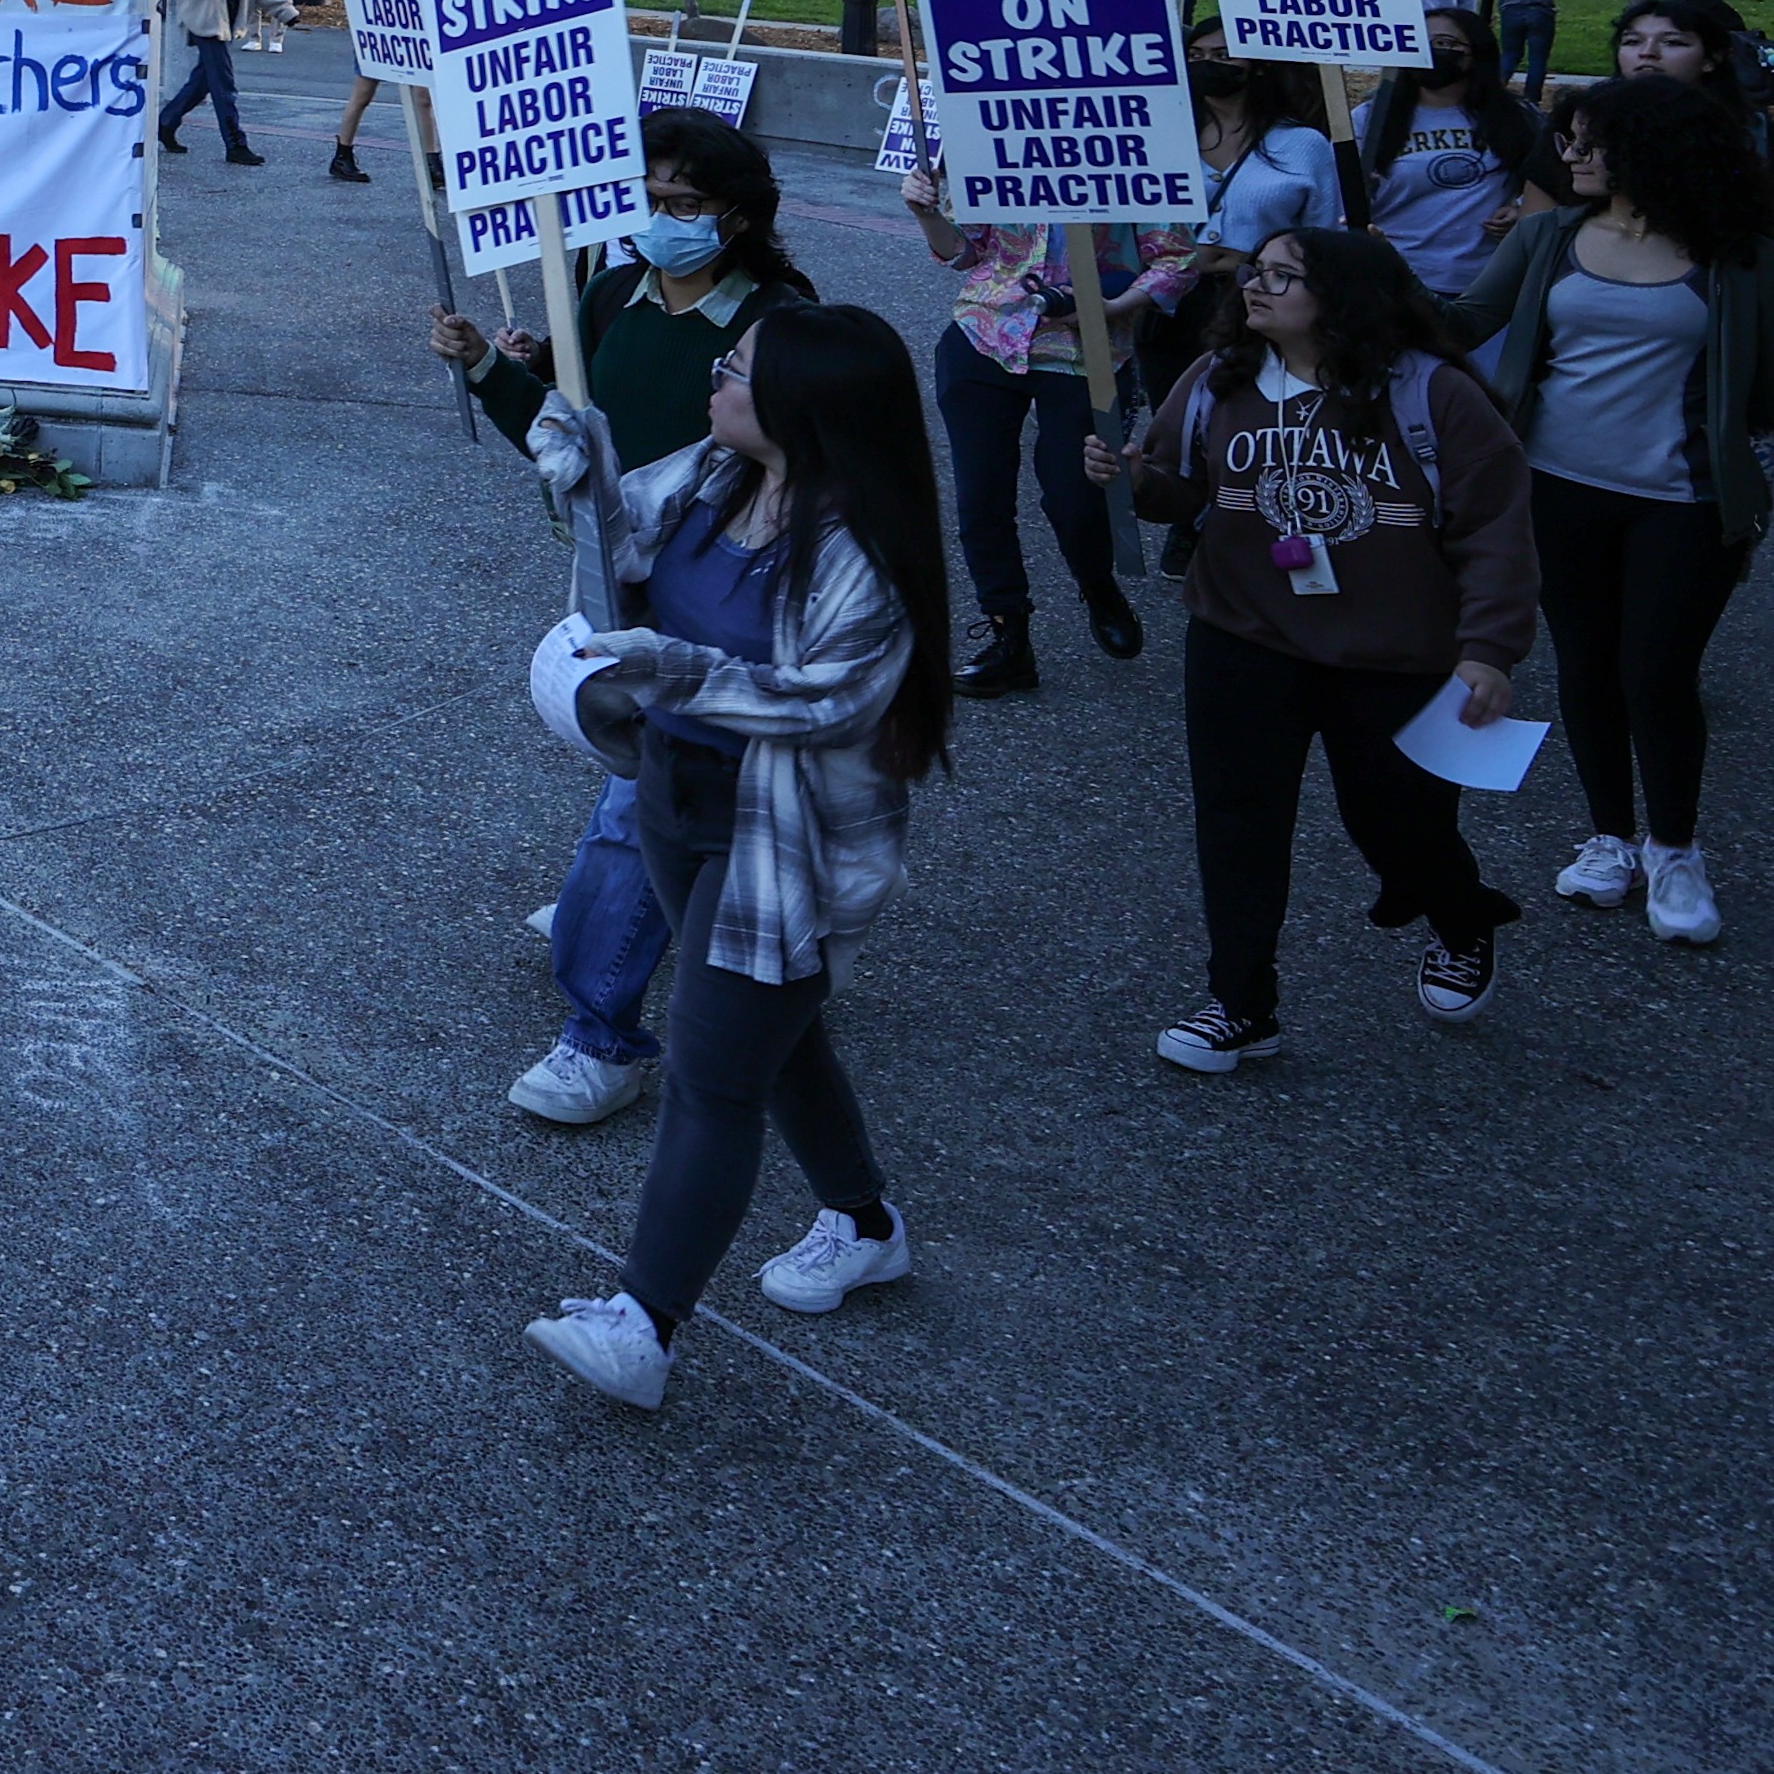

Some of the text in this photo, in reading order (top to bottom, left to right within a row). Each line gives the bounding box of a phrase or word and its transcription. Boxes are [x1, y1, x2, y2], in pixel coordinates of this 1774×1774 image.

[357, 30, 433, 71] PRACTIC
[1235, 18, 1419, 53] PRACTICE
[465, 25, 595, 92] UNFAIR
[648, 55, 692, 68] PRACTICE
[653, 66, 683, 78] LABOR
[703, 62, 752, 76] PRACTICE
[947, 32, 1168, 82] STRIKE
[650, 76, 683, 88] UNFAIR
[703, 83, 739, 97] UNFAIR
[708, 73, 740, 85] LABOR
[476, 76, 593, 138] LABOR
[642, 90, 688, 106] STRIKE
[693, 97, 741, 115] STRIKE
[979, 94, 1151, 131] UNFAIR
[456, 117, 631, 190] PRACTICE
[993, 134, 1148, 169] LABOR
[965, 172, 1193, 207] PRACTICE
[1227, 428, 1400, 490] OTTAWA
[1298, 488, 1330, 514] 91
